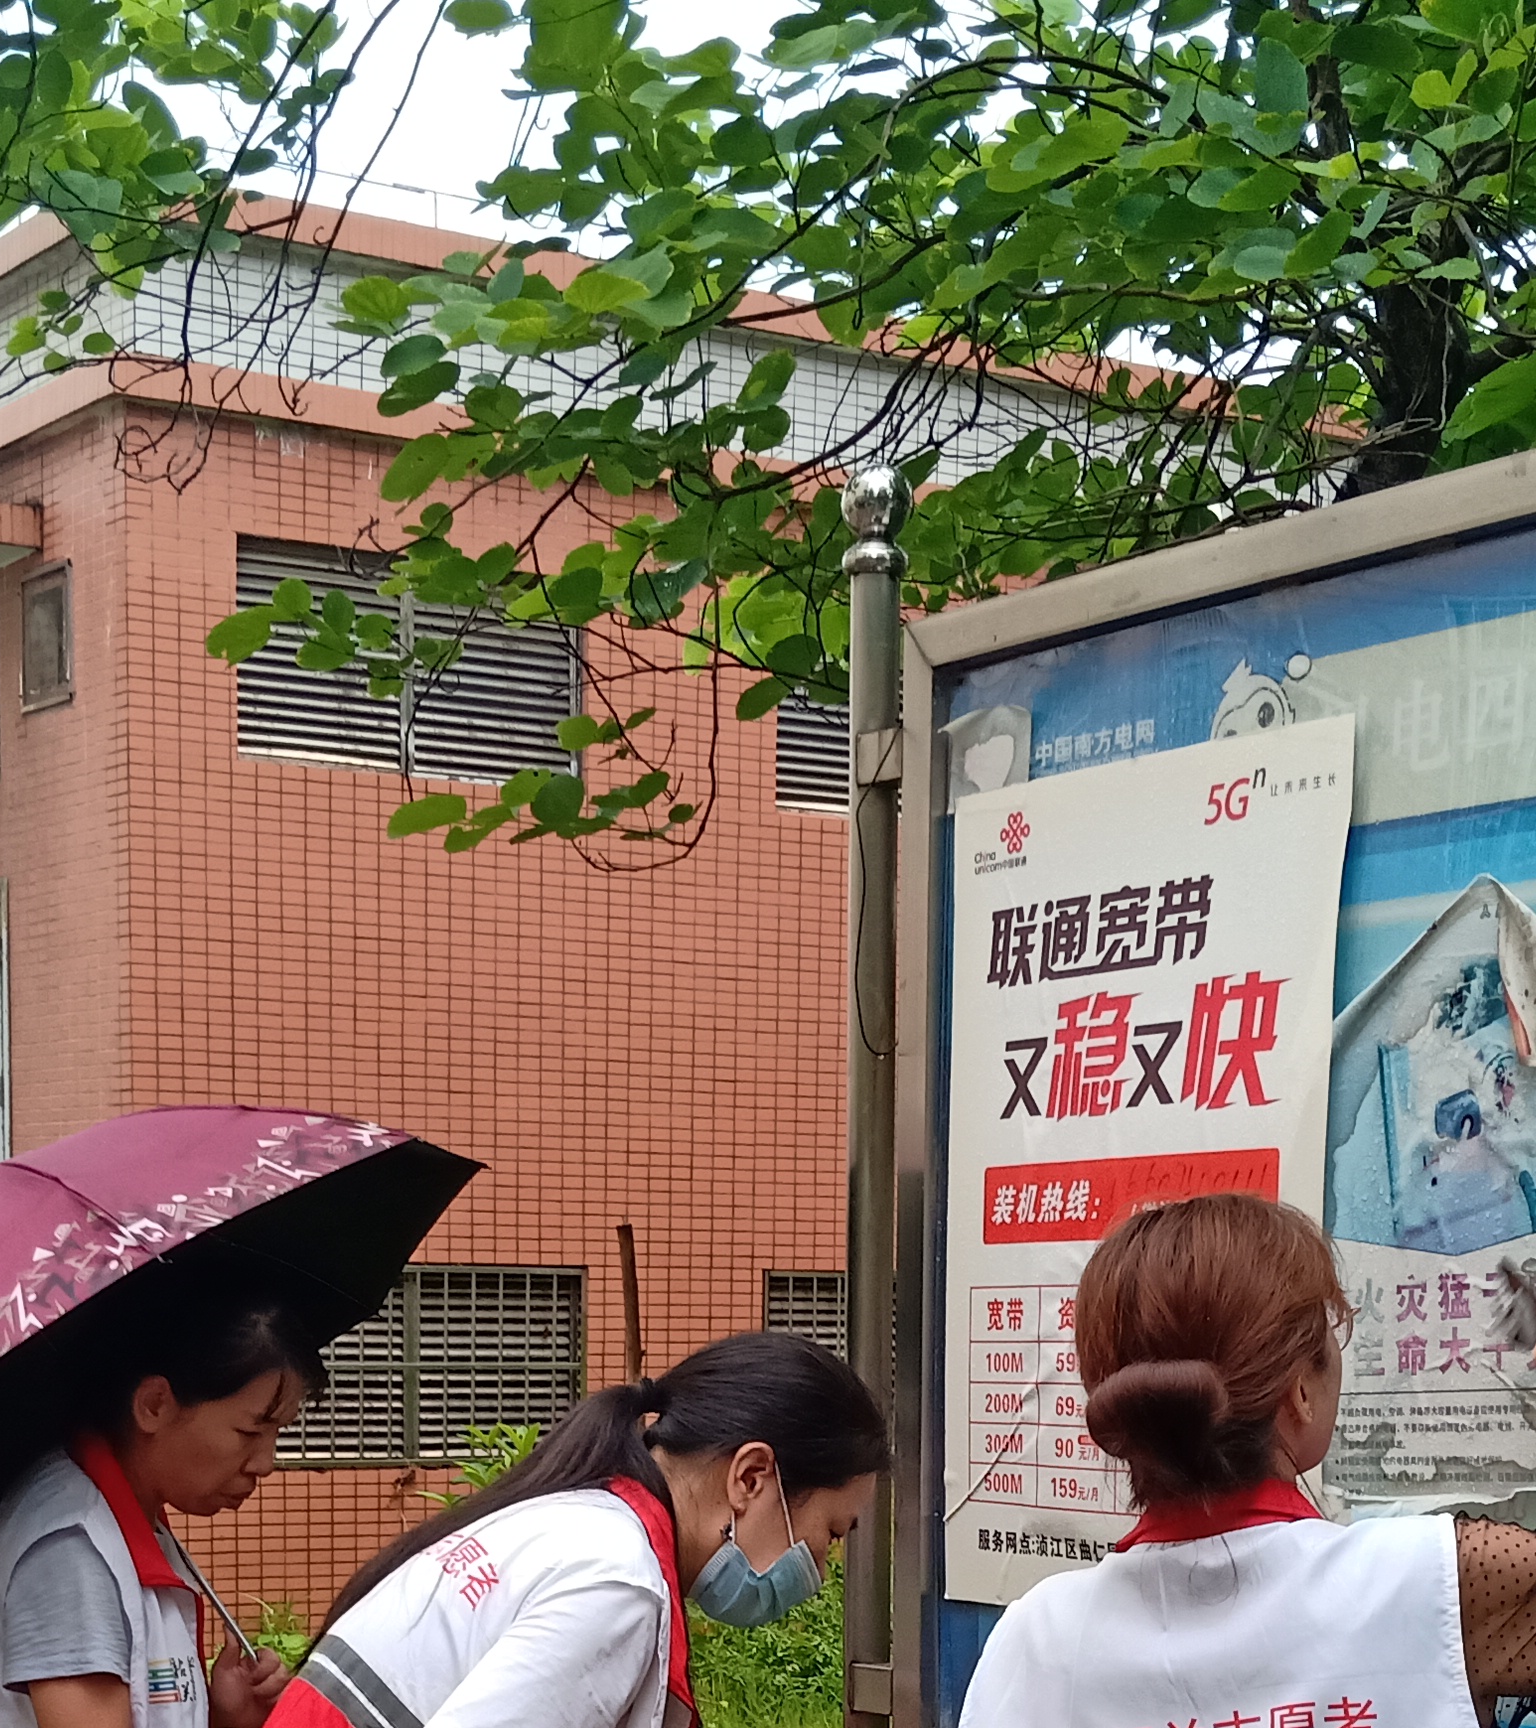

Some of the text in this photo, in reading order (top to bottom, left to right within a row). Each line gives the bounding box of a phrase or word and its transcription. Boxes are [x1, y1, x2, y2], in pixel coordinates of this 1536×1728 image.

[1035, 719, 1155, 767] 中国南方电网
[974, 850, 996, 864] China
[986, 874, 1214, 989] 联通宽带
[999, 970, 1293, 1122] 又稳又快
[990, 1179, 1101, 1226] 装机热线：
[986, 1297, 1024, 1332] 宽带
[985, 1352, 1024, 1373] 100M
[984, 1392, 1024, 1415] 200M
[984, 1433, 1024, 1454] 300M
[983, 1472, 1024, 1495] 500M
